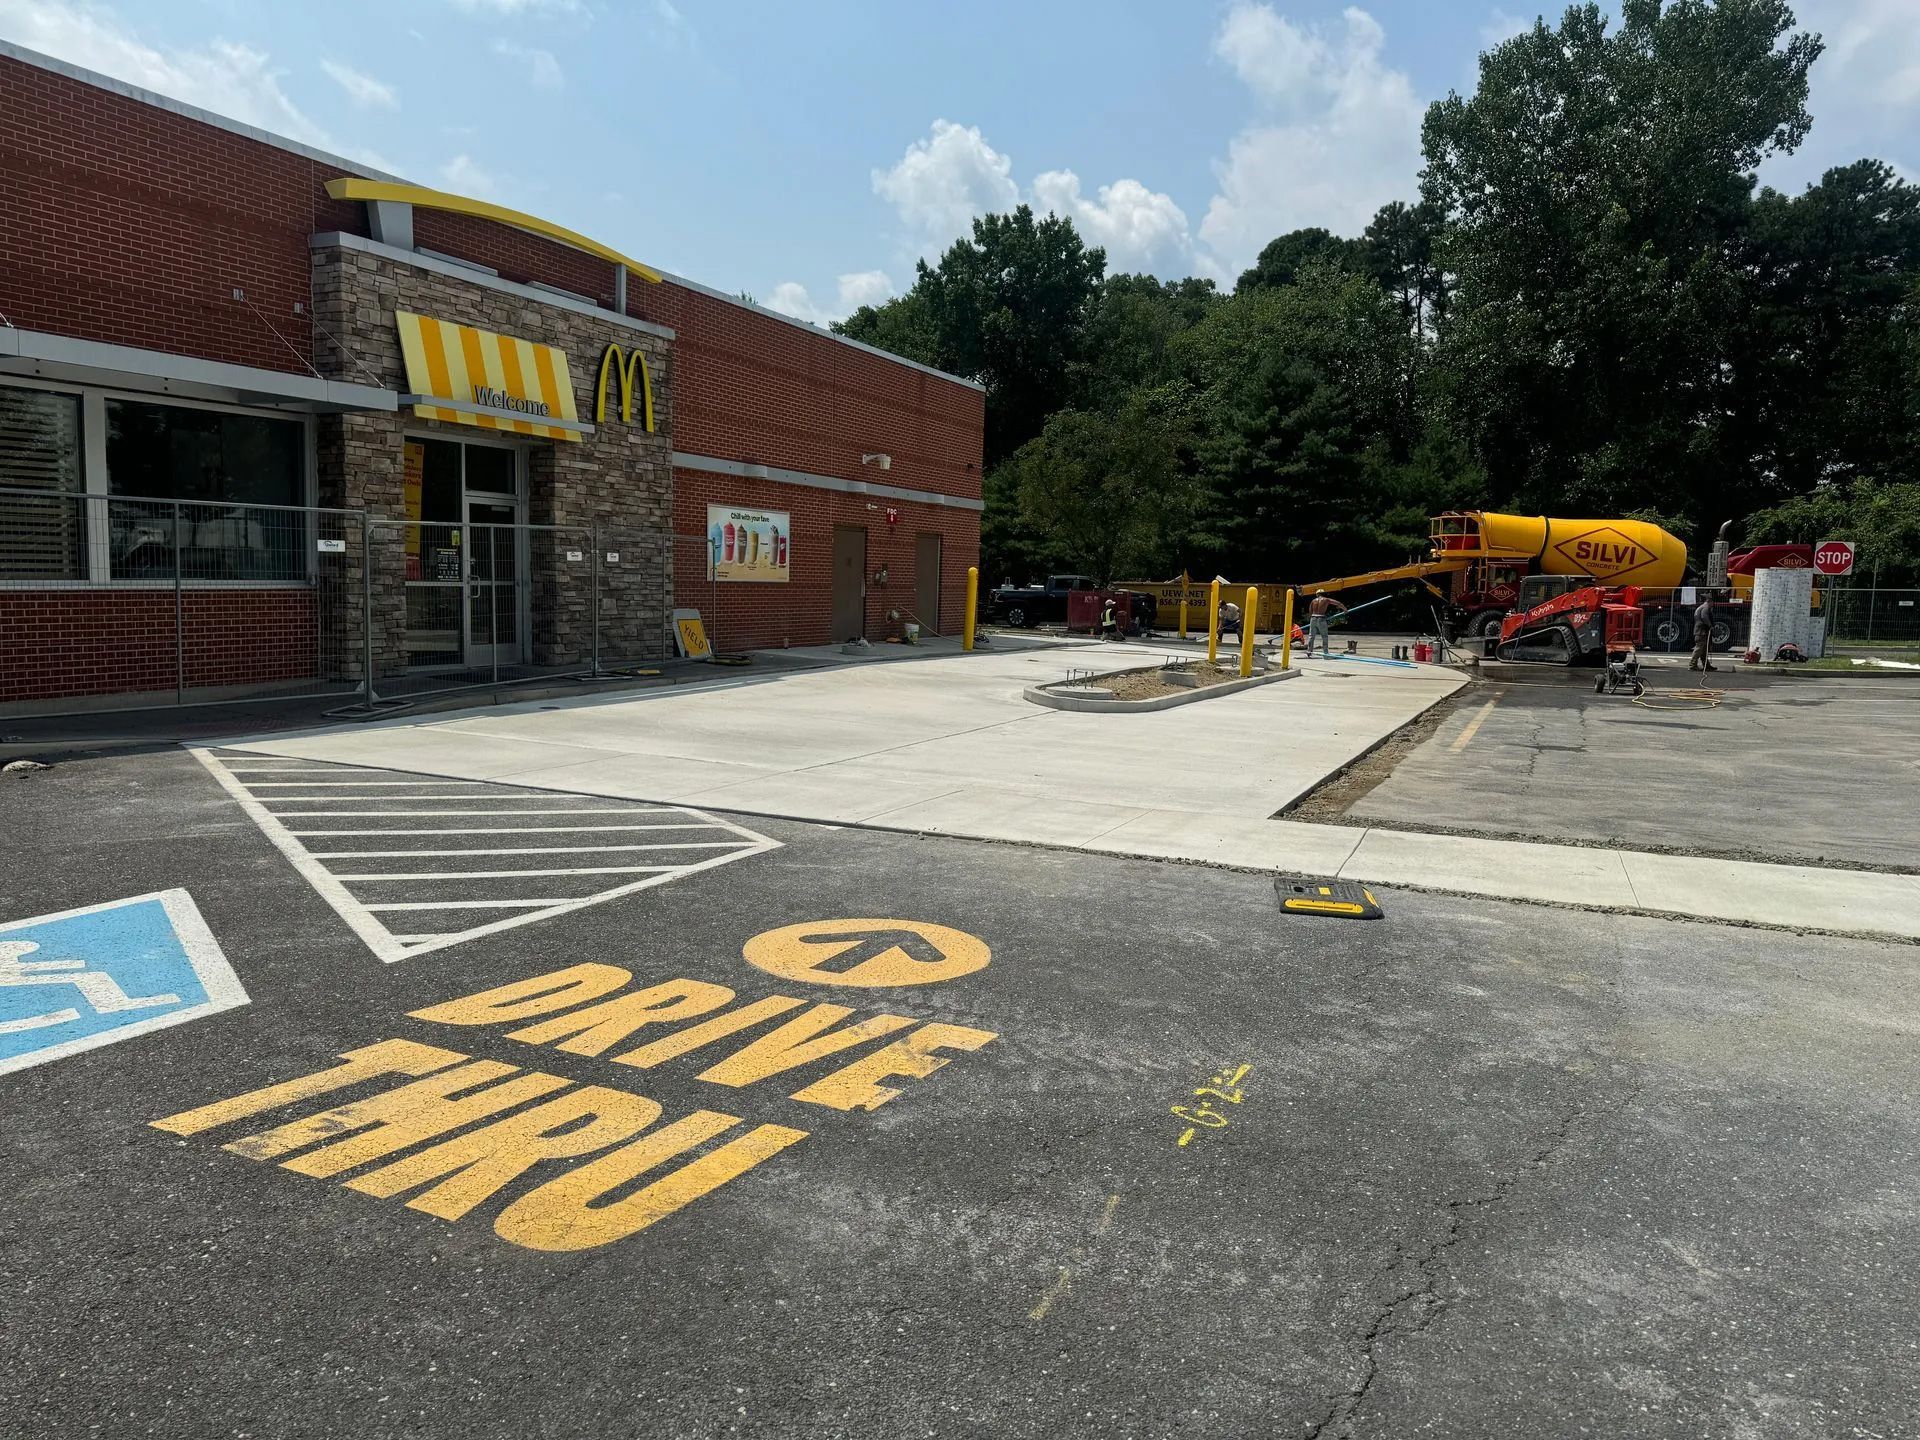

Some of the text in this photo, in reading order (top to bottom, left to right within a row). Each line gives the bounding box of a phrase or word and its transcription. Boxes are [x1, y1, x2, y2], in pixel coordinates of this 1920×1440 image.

[474, 384, 551, 417] Welcome
[730, 512, 741, 520] Chill
[1575, 540, 1637, 566] SILVI
[1783, 558, 1802, 566] SILVI
[1816, 551, 1851, 565] STOP
[1586, 561, 1621, 571] CONCRETE
[1531, 603, 1555, 617] Kubota
[684, 623, 704, 650] YIELD
[406, 962, 999, 1112] DRIVE
[148, 1037, 810, 1252] THRU
